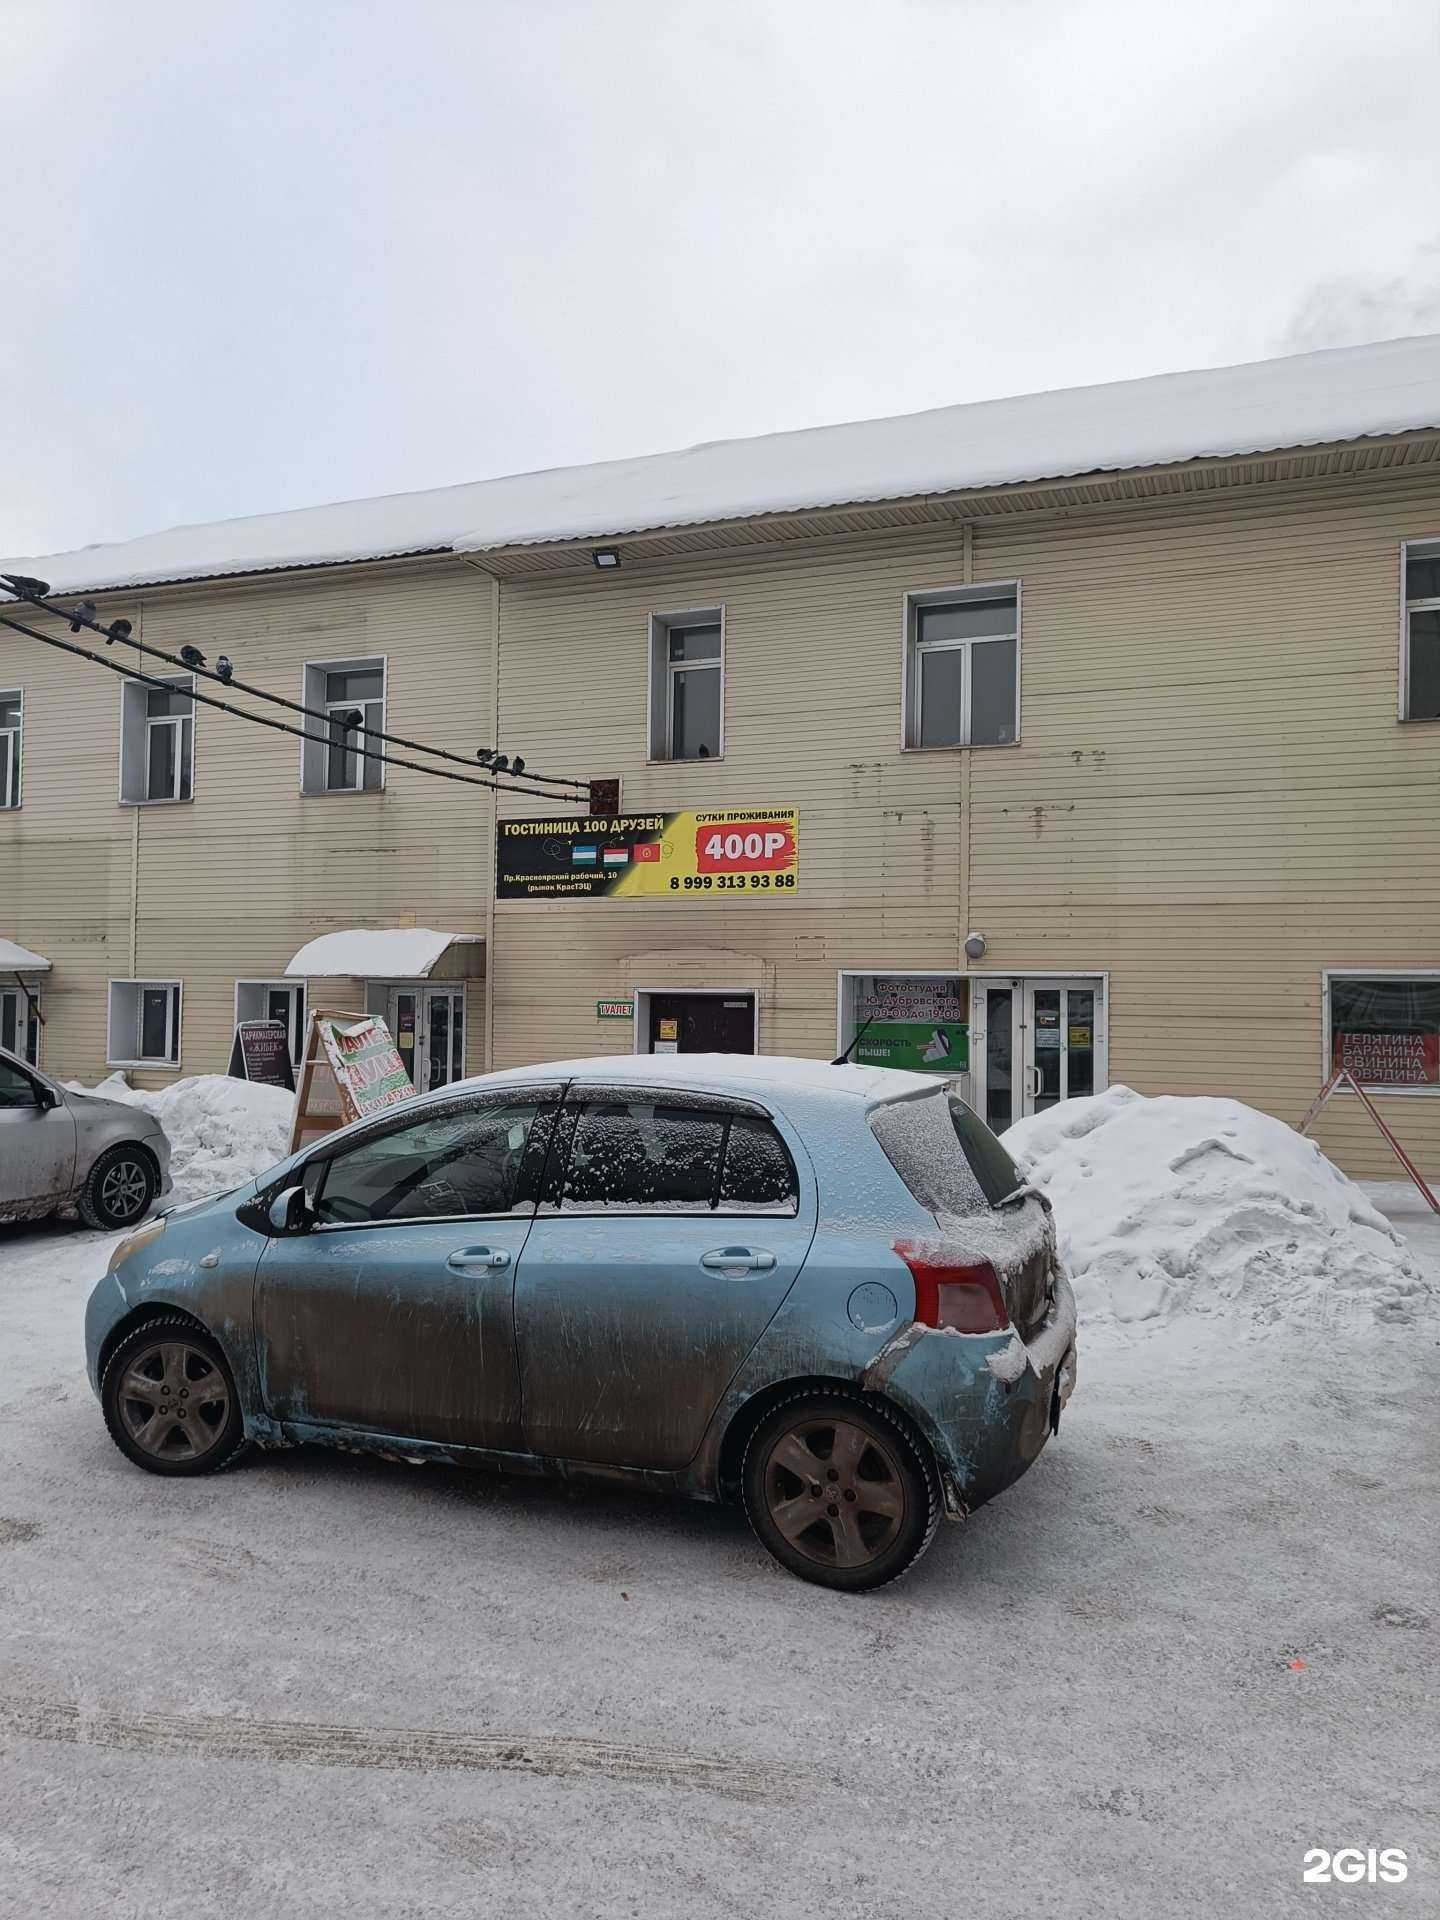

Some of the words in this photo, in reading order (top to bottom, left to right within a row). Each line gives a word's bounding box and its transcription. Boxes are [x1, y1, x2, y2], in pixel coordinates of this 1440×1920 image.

[696, 813, 725, 822] СУТКИ
[727, 810, 794, 821] ПРОЖИВАНИЯ
[504, 821, 580, 837] ГОСТИНИЦА
[584, 820, 607, 833] 100
[610, 815, 664, 834] ДРУЗЕЙ
[704, 832, 786, 860] 400Р
[571, 872, 606, 882] рабочий,
[608, 872, 618, 880] 10
[670, 877, 680, 890] 8
[684, 876, 712, 889] 999
[717, 875, 746, 889] 313
[750, 874, 770, 888] 93
[774, 874, 795, 887] 88
[878, 983, 946, 993] Фотостудия
[883, 996, 960, 1007] Дубровского
[600, 1003, 633, 1016] ТУАЛЕТ
[873, 1008, 908, 1018] 09-00
[911, 1011, 925, 1020] до
[929, 1009, 961, 1020] 19-00
[858, 1038, 912, 1047] СКОРОСТЬ
[1343, 1033, 1424, 1046] ТЕЛЯТИНА
[858, 1048, 891, 1057] ВЫШЕ!
[1343, 1044, 1426, 1057] БАРАНИНА
[1343, 1055, 1422, 1069] СВИНИНА
